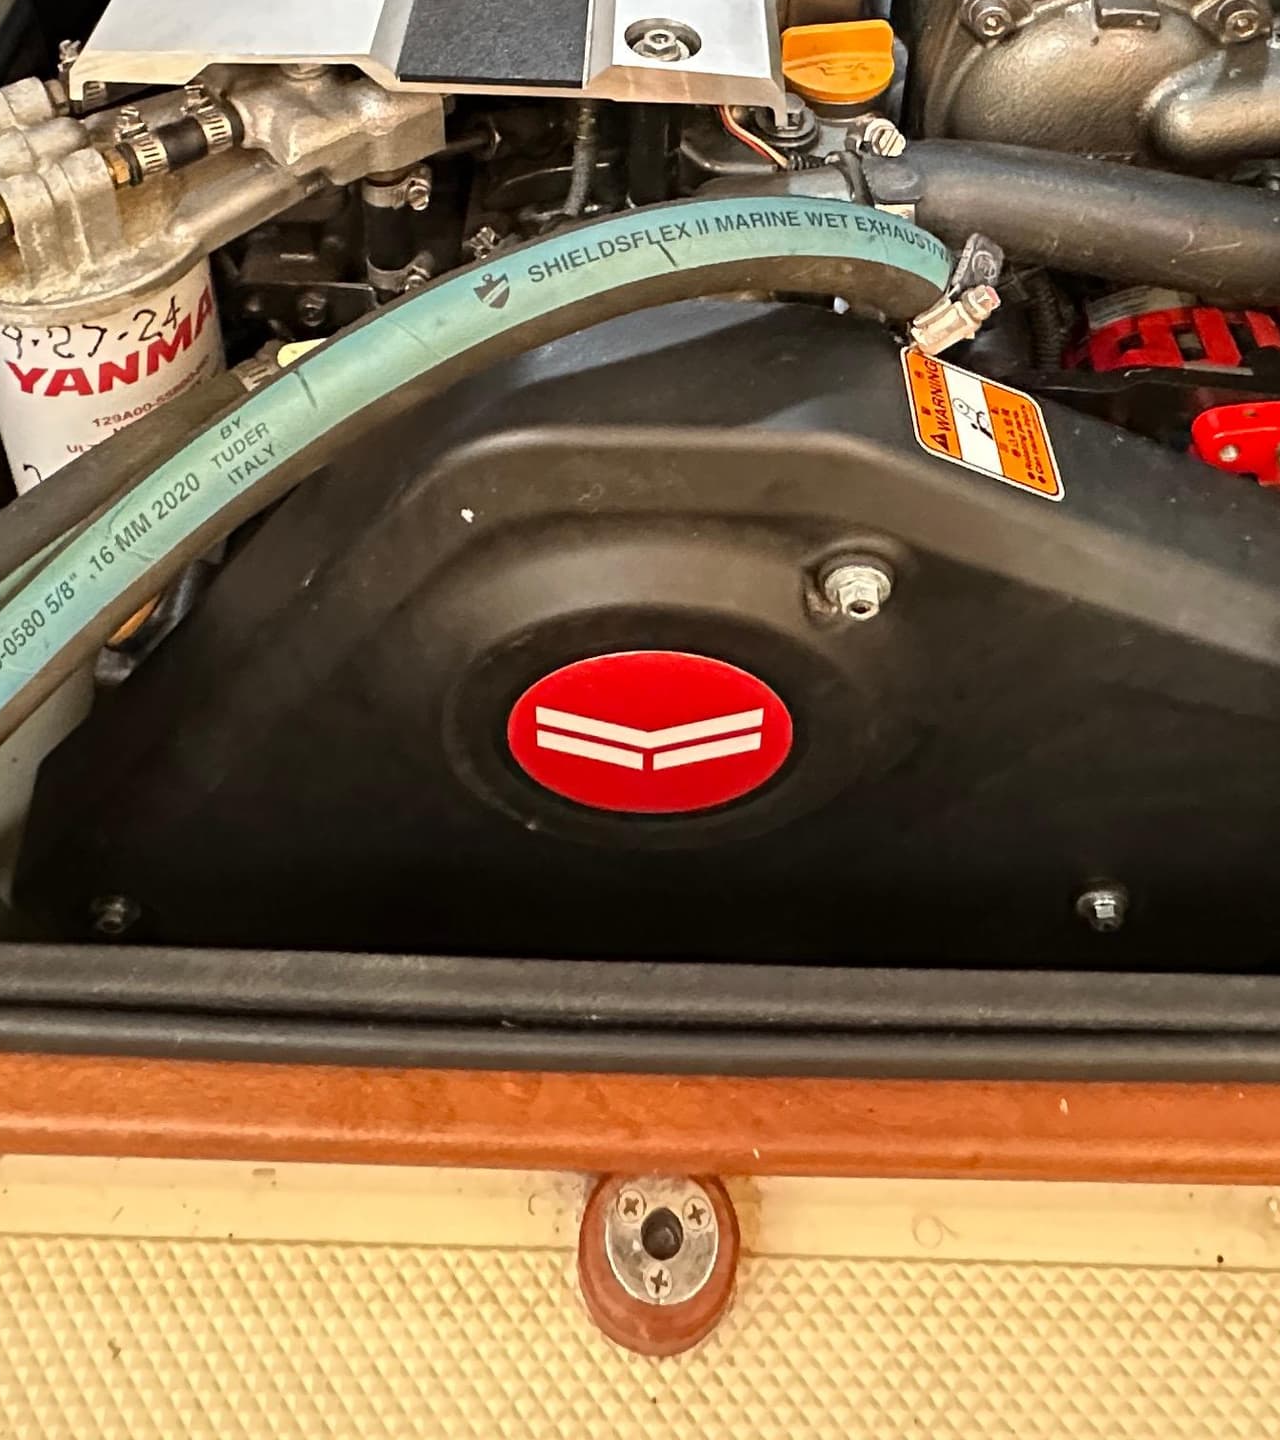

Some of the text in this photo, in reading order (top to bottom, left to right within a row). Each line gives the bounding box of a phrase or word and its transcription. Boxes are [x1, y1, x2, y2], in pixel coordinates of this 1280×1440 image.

[527, 218, 692, 286] SHIELDSFLEX
[697, 215, 710, 238] II
[715, 210, 801, 234] MARINE
[805, 211, 849, 230] WET
[4, 285, 214, 397] YANMA
[220, 416, 242, 441] BY
[924, 359, 952, 432] WARNING
[210, 422, 270, 470] TUDER
[227, 443, 277, 486] ITALY
[44, 572, 78, 615] 5/8"
[114, 513, 153, 553] MM
[151, 472, 201, 520] 2020
